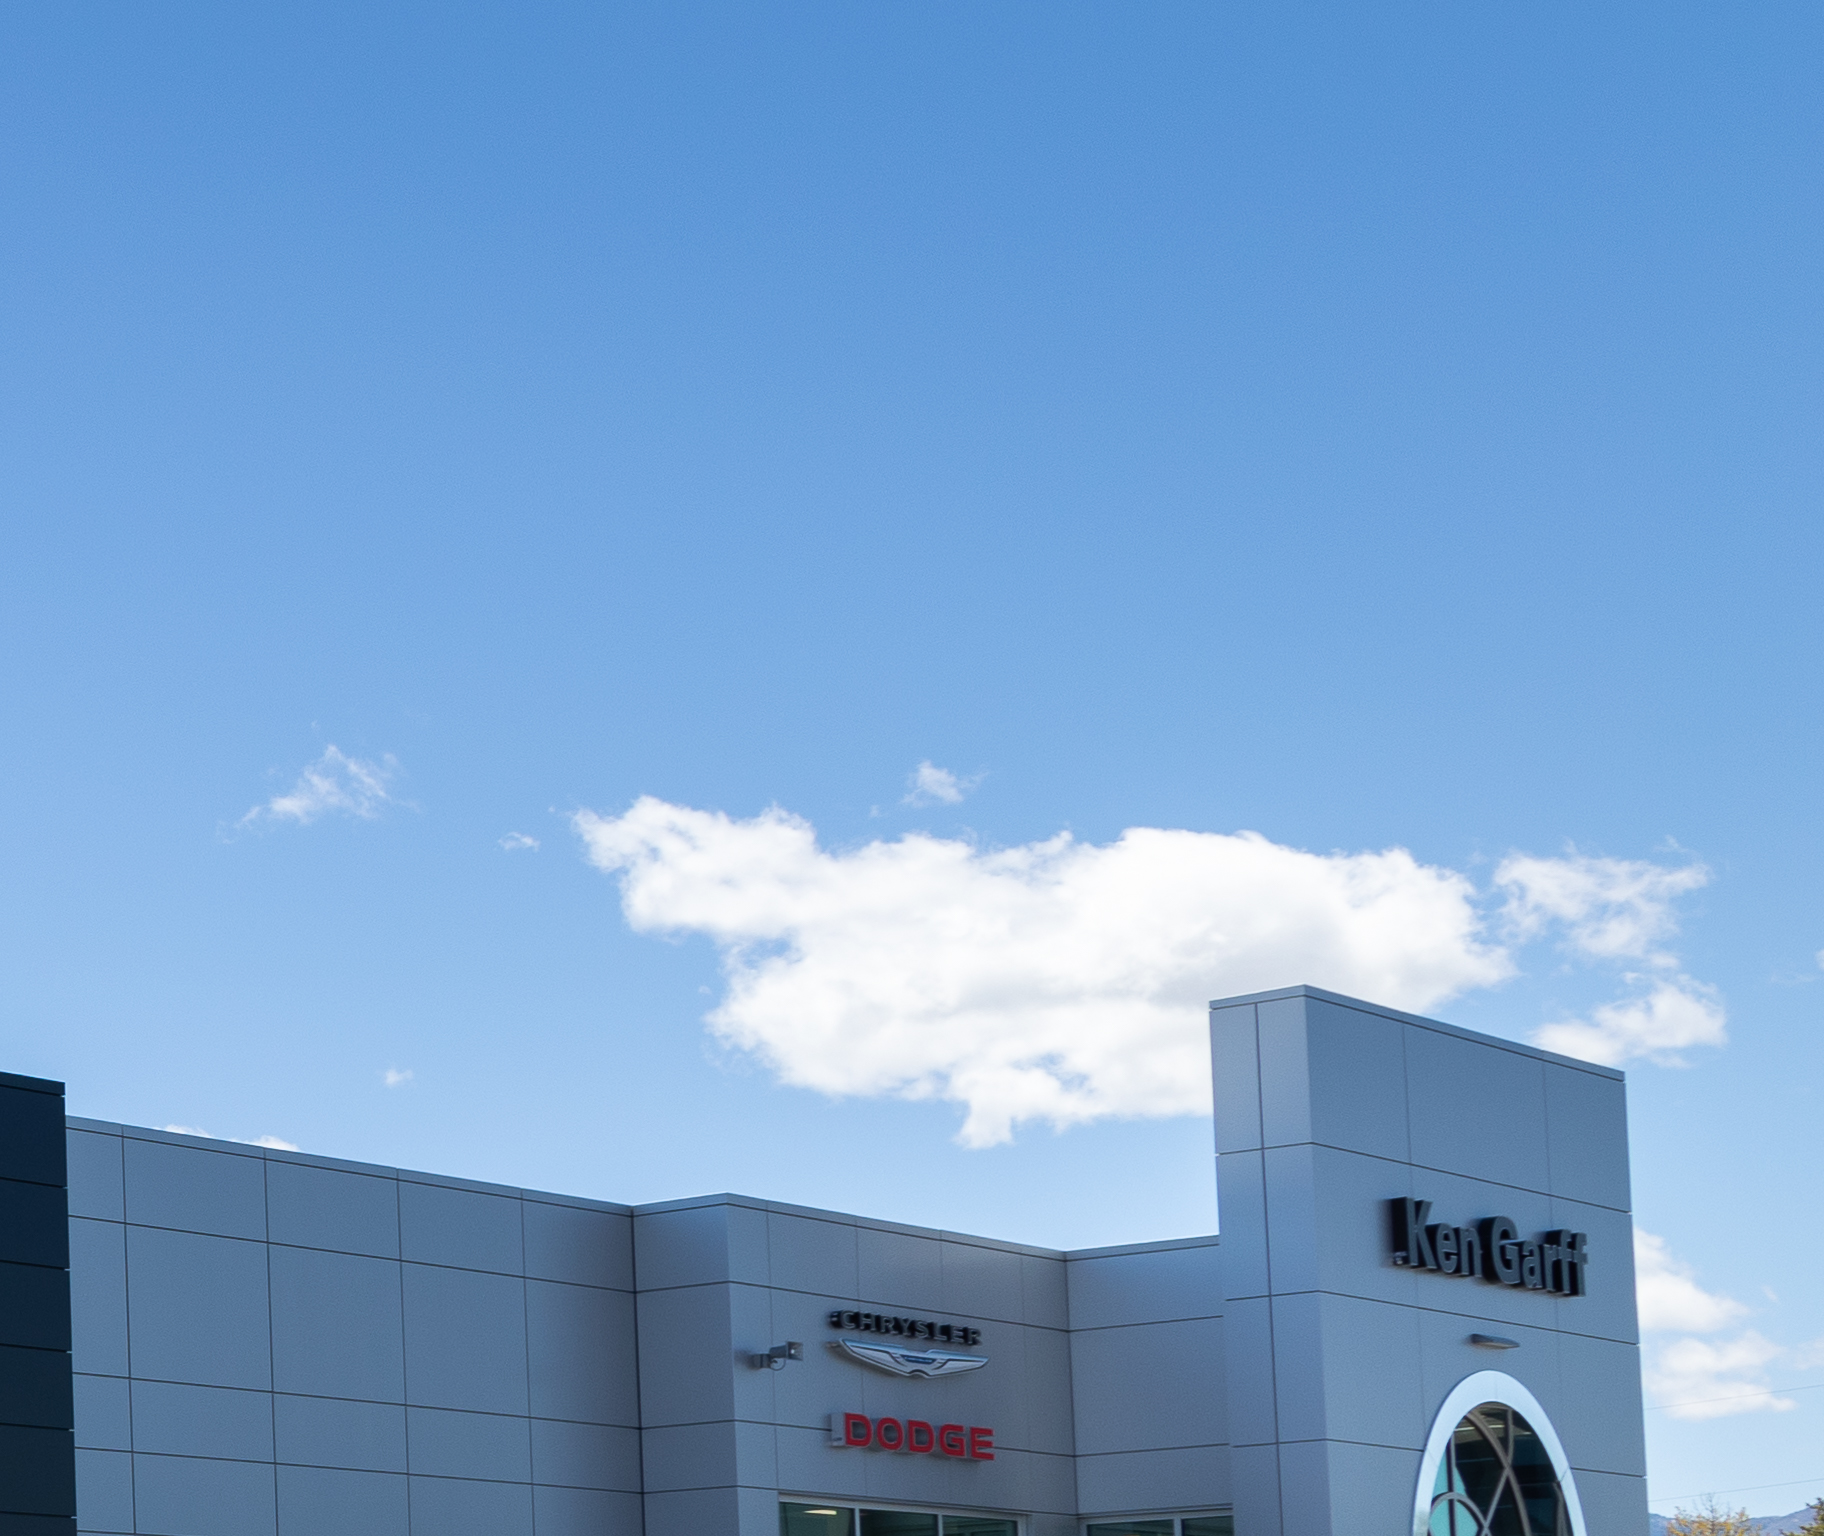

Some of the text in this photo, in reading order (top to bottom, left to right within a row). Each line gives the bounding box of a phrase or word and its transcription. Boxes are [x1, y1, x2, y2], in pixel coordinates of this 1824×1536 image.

[1395, 1197, 1588, 1297] Ken Garff
[834, 1310, 982, 1345] CHRYSLER
[842, 1412, 995, 1461] DODGE
